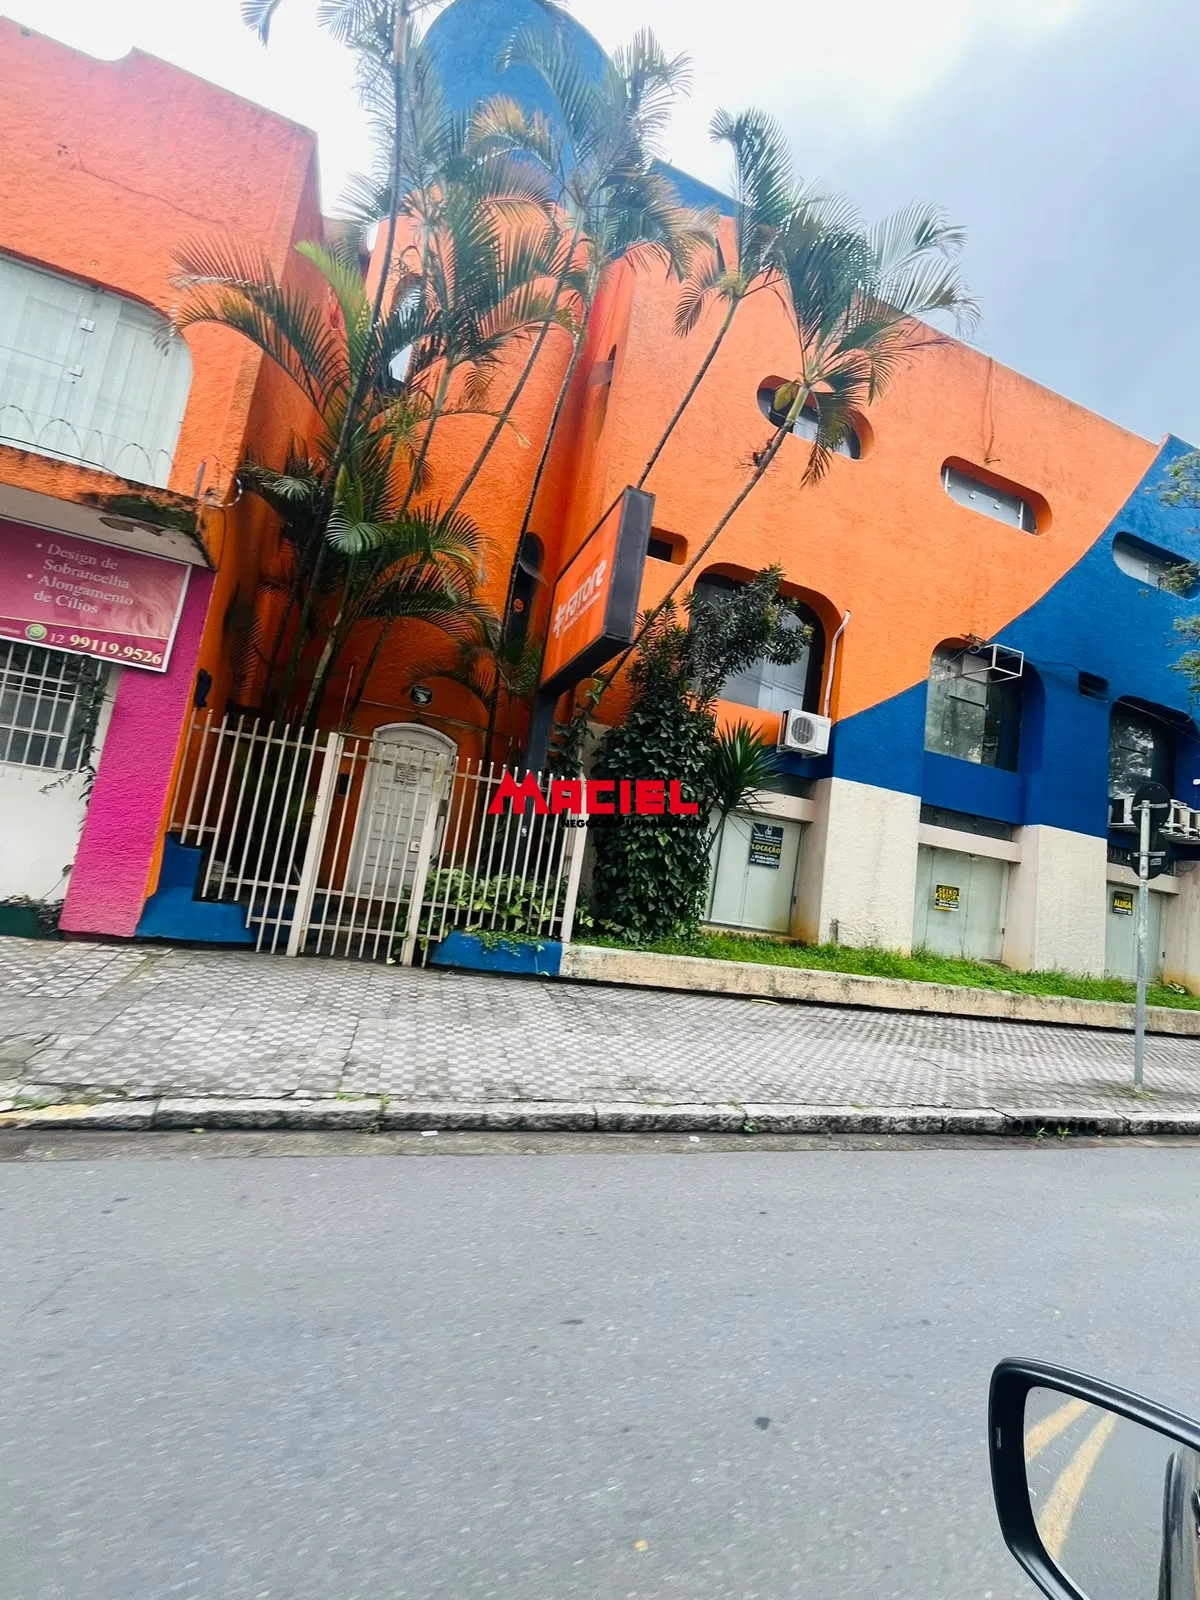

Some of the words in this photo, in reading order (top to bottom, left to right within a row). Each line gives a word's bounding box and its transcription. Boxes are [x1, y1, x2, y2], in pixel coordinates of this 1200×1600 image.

[47, 543, 97, 565] Design
[101, 558, 118, 570] de
[43, 559, 129, 589] Sobrancelha
[33, 590, 52, 603] de
[55, 594, 98, 614] Cílios
[37, 575, 134, 606] Alongamento
[50, 633, 65, 644] 12
[69, 634, 163, 665] 99119.9526
[751, 843, 781, 854] LOCAÇÃO
[1113, 898, 1132, 909] ALUGA
